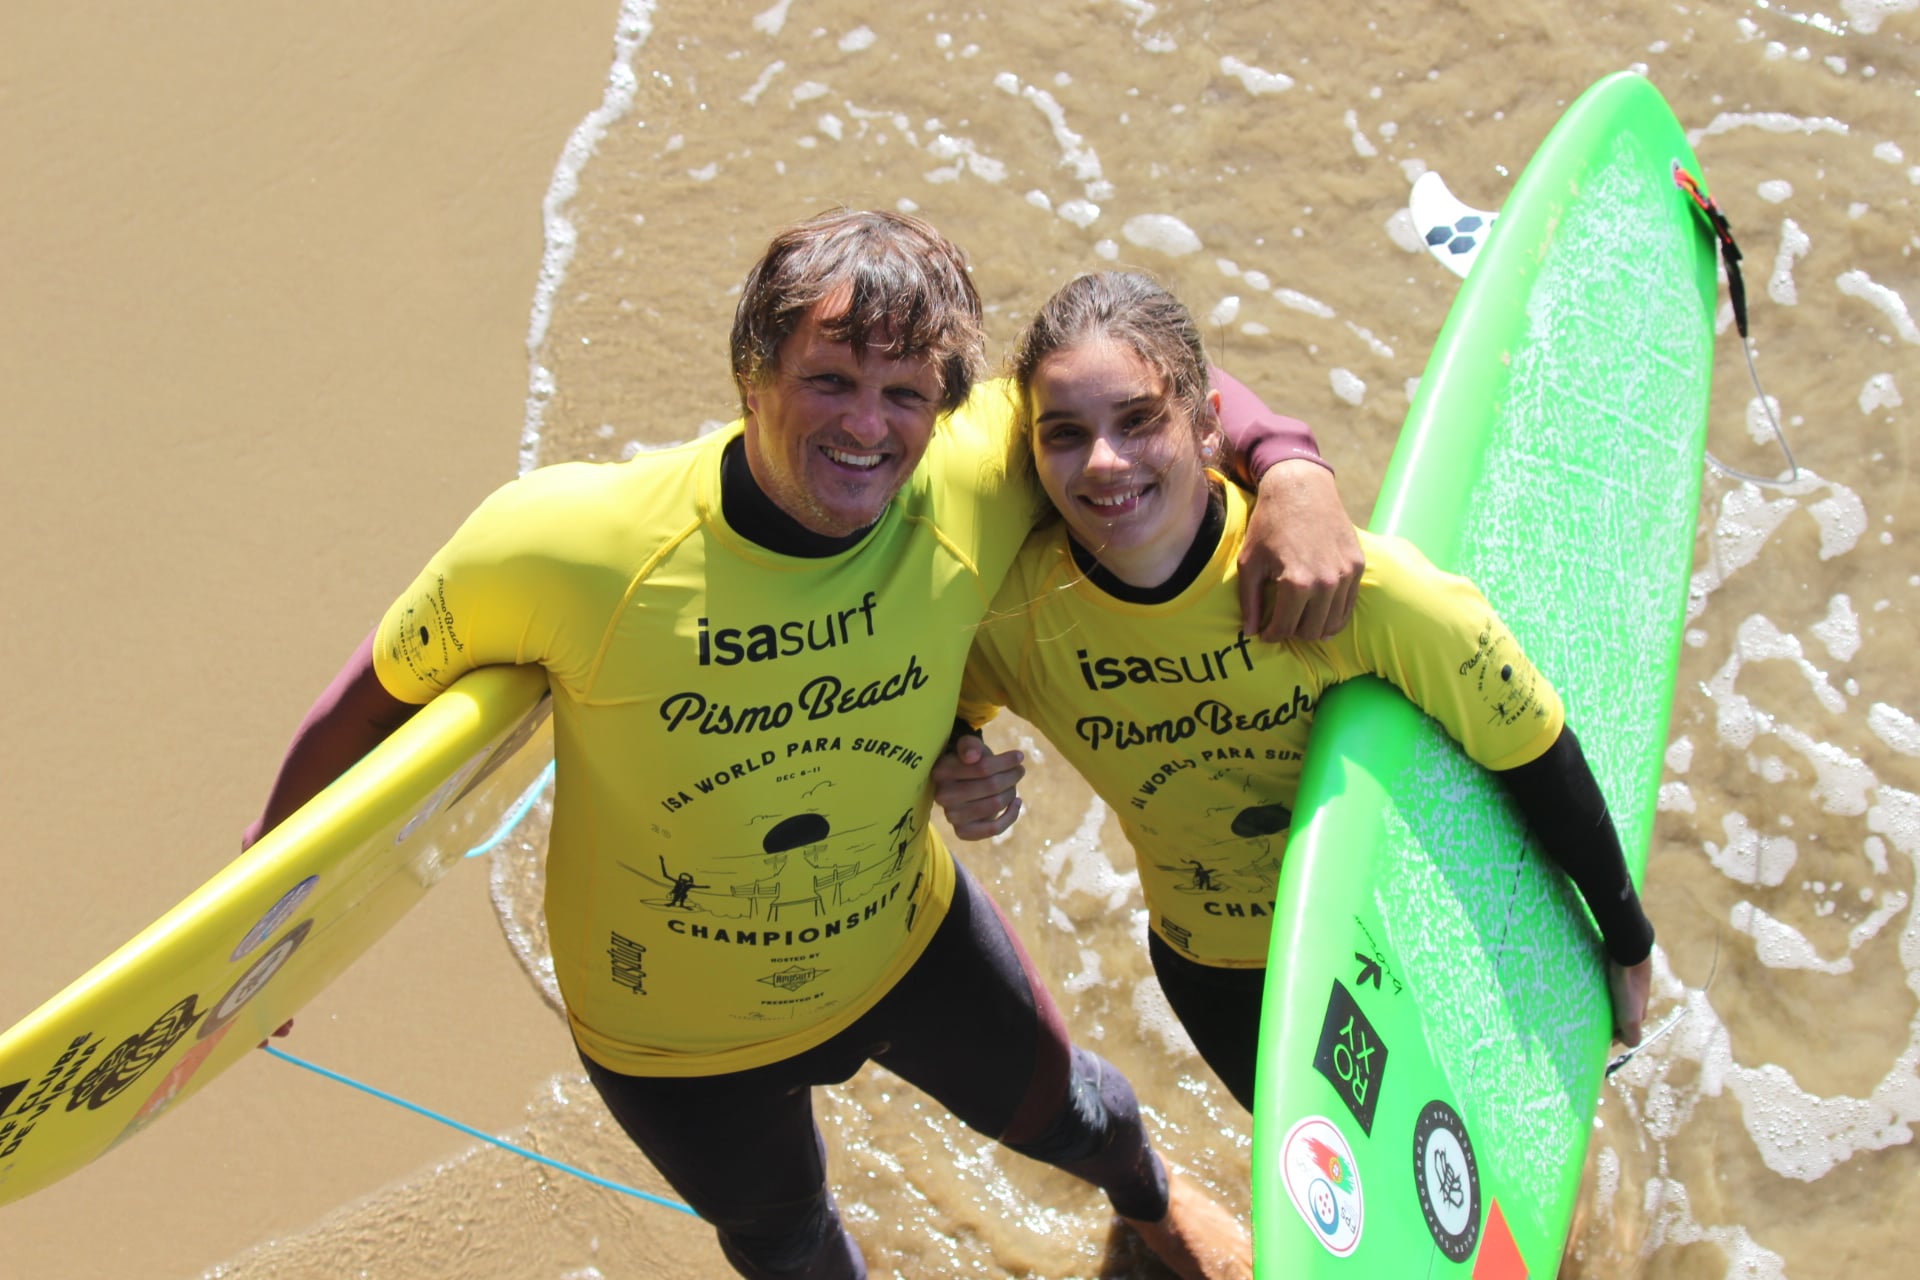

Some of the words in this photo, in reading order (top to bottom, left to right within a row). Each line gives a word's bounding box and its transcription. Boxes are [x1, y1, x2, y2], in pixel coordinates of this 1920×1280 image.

[444, 611, 465, 653] Beach
[697, 591, 877, 666] isasurf
[1077, 630, 1255, 691] isasurf
[659, 691, 794, 735] Pismo
[798, 654, 930, 722] Beach
[1076, 715, 1196, 751] Pismo
[1194, 684, 1315, 736] Beach
[661, 791, 695, 814] ISA
[694, 750, 777, 795] WORLD
[786, 736, 842, 759] PARA
[851, 736, 924, 771] SURFING
[776, 772, 796, 783] DEC
[1201, 746, 1256, 763] PARA
[667, 882, 901, 947] CHAMPIONSHIP
[770, 955, 806, 963] HOSTED
[808, 952, 820, 960] BY
[761, 996, 812, 1005] PRESENTED
[813, 991, 825, 999] BY
[0, 1121, 37, 1158] DE
[26, 1036, 107, 1122] VIANA
[16, 1032, 94, 1115] CLUBE
[1340, 1206, 1358, 1236] FPS
